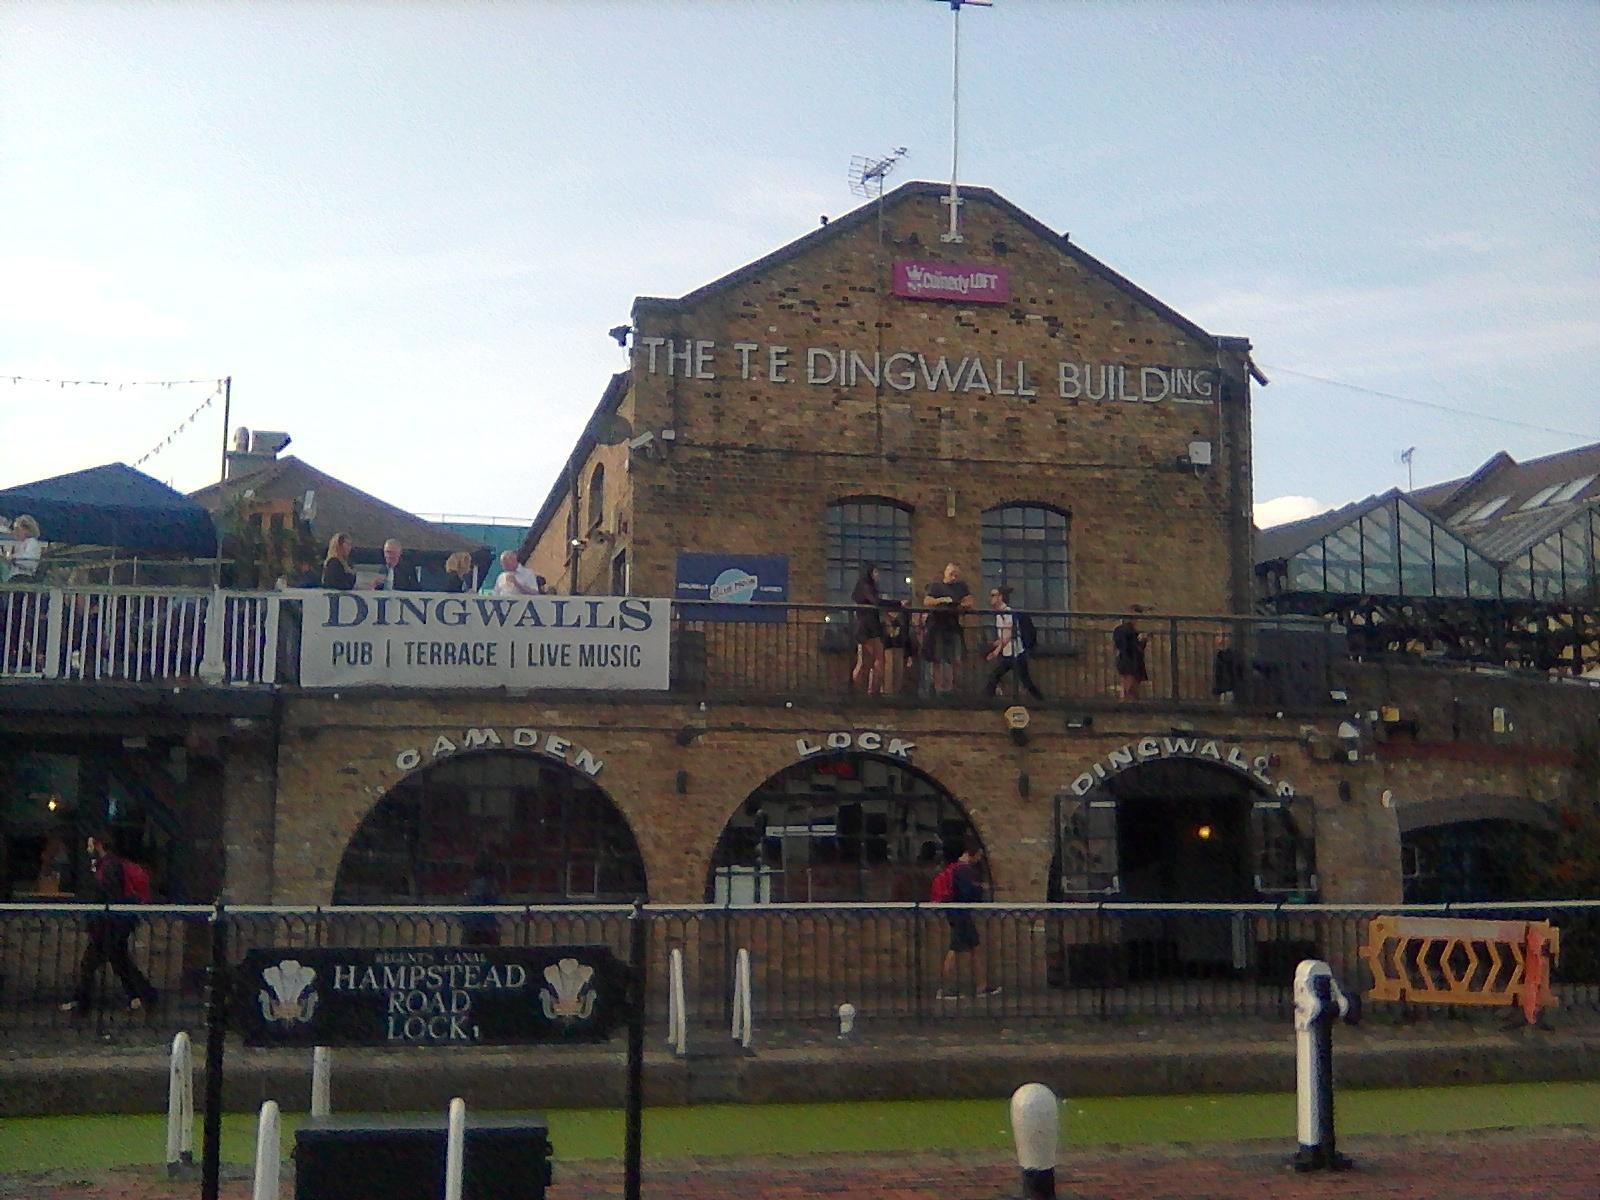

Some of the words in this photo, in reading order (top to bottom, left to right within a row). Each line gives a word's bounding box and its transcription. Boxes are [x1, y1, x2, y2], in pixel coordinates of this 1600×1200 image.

[642, 336, 715, 380] THE
[807, 347, 1037, 397] DINGWALL
[1058, 361, 1213, 404] BUILDING
[322, 591, 653, 632] DINGWALLS
[332, 640, 373, 667] PUB
[404, 641, 497, 668] TERRACE
[527, 643, 571, 668] LIVE
[579, 644, 641, 668] MUSIC
[796, 732, 915, 757] LOCK
[333, 964, 527, 990] HAMPSTEAD
[388, 989, 471, 1014] ROAD
[388, 1015, 467, 1040] LOCK
